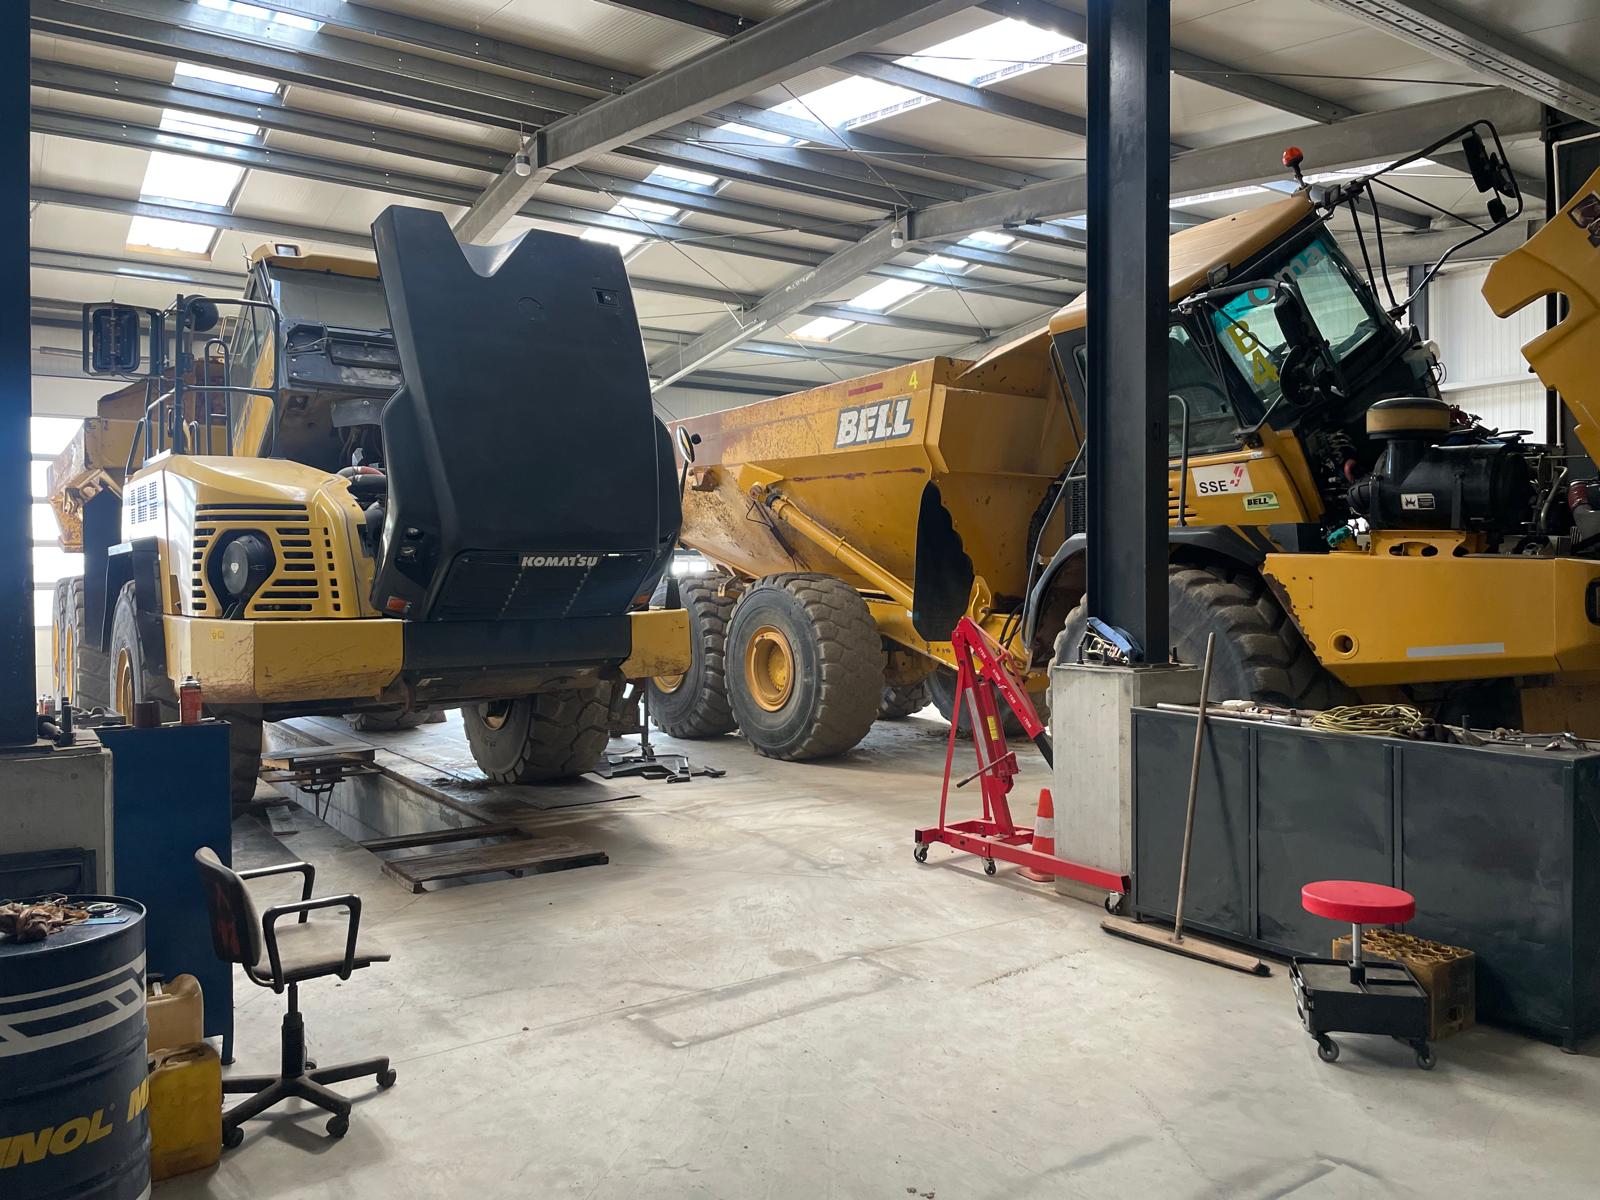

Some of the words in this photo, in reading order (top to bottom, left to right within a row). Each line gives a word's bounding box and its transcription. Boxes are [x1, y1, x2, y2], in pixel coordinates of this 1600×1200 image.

[908, 369, 919, 390] 4
[835, 399, 912, 446] BELL
[1199, 480, 1229, 494] SSE
[1246, 497, 1270, 506] BELL
[521, 555, 598, 567] KOMATSU
